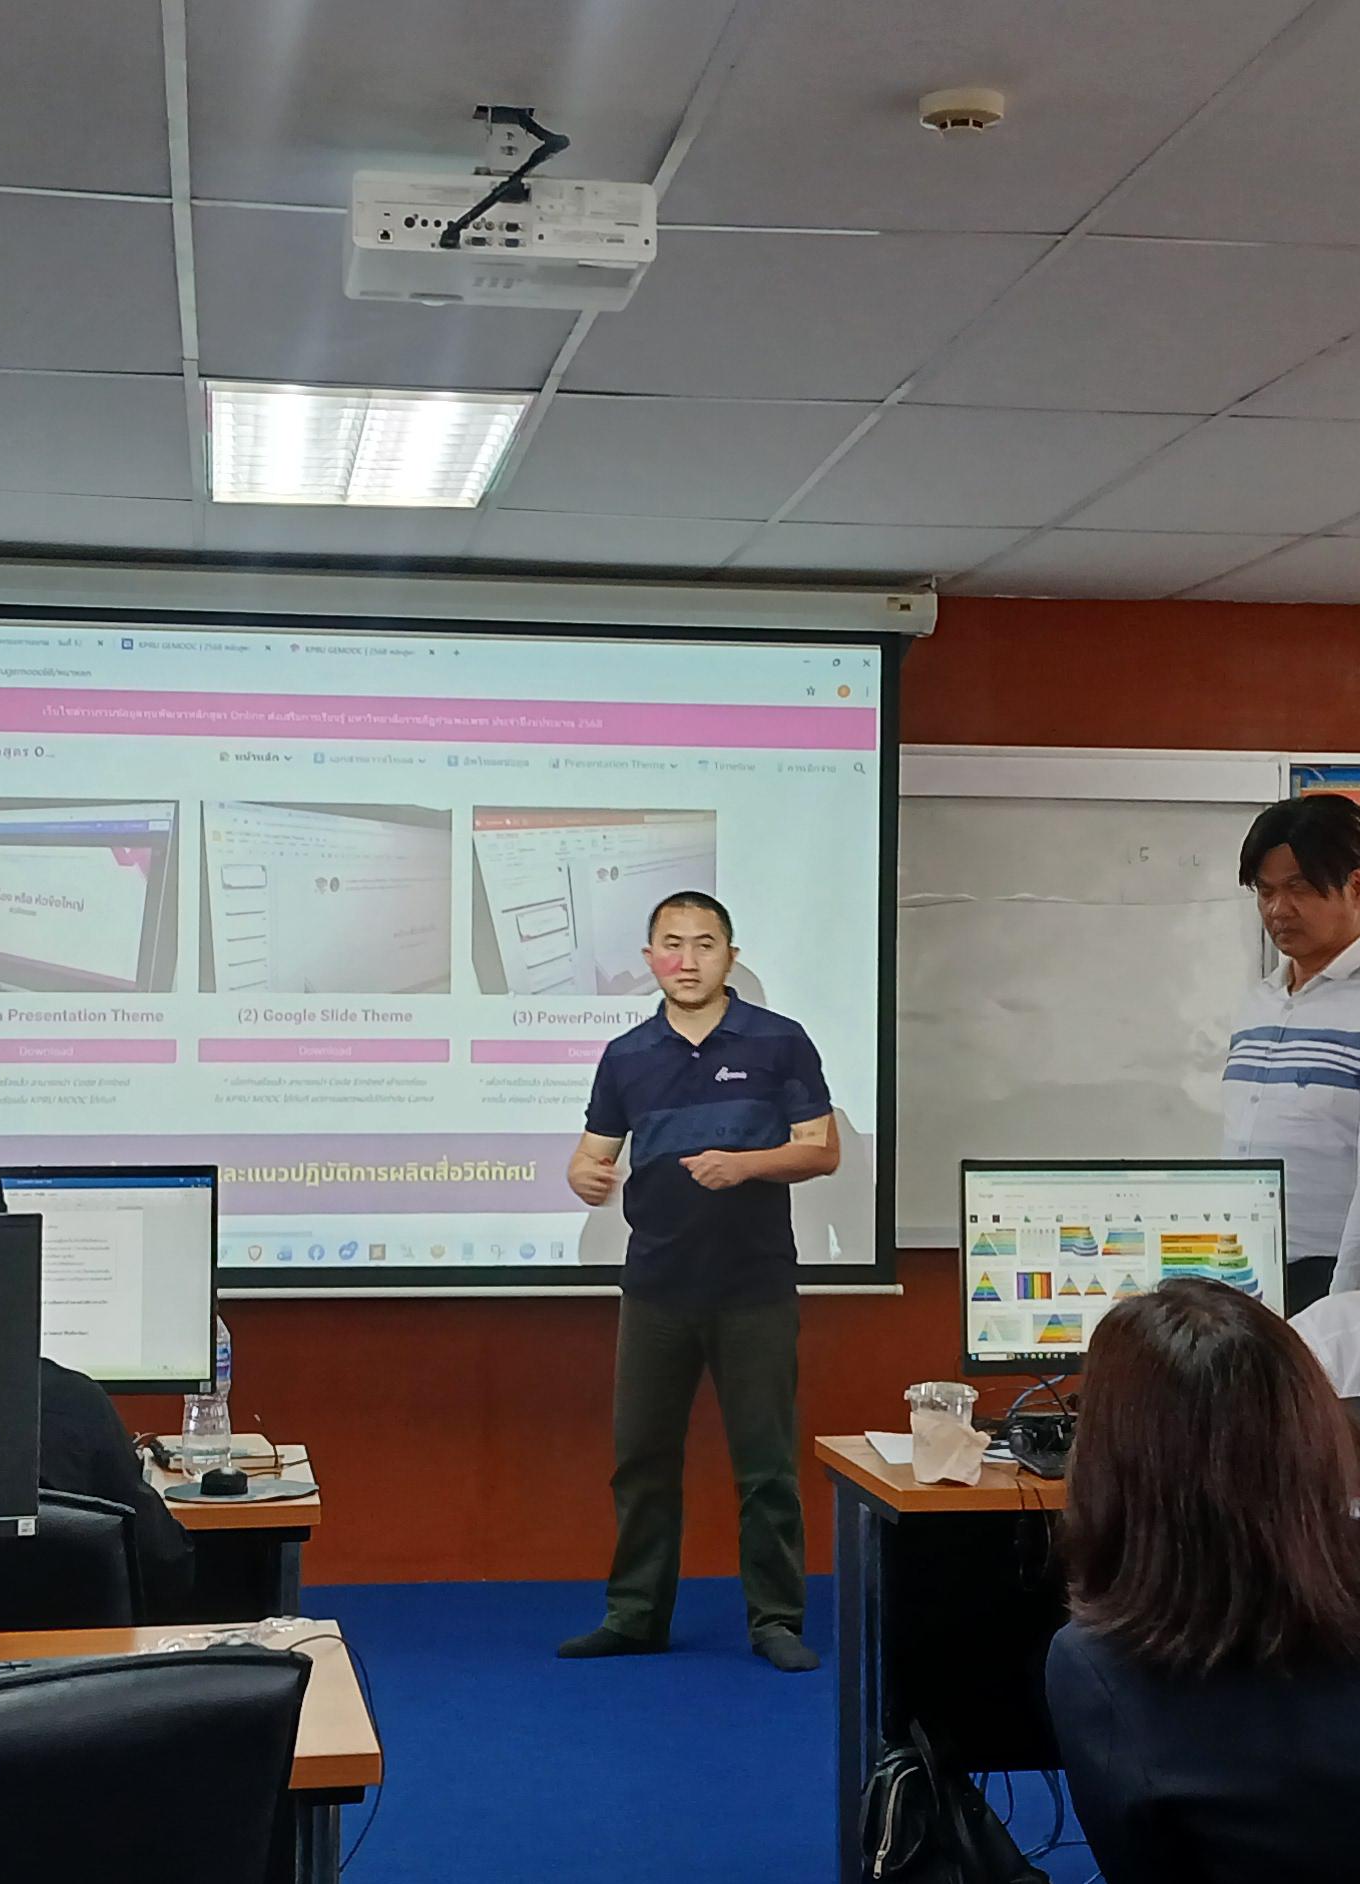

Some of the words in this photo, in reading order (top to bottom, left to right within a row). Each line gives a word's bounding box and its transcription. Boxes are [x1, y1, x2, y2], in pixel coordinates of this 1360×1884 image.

[8, 1008, 107, 1023] Presentation
[110, 1008, 165, 1023] Theme
[238, 1008, 258, 1025] (2)
[263, 1009, 317, 1026] Google
[321, 1008, 358, 1023] Slide
[361, 1009, 413, 1023] Theme
[512, 1011, 533, 1027] (3)
[537, 1012, 621, 1025] PowerPoint
